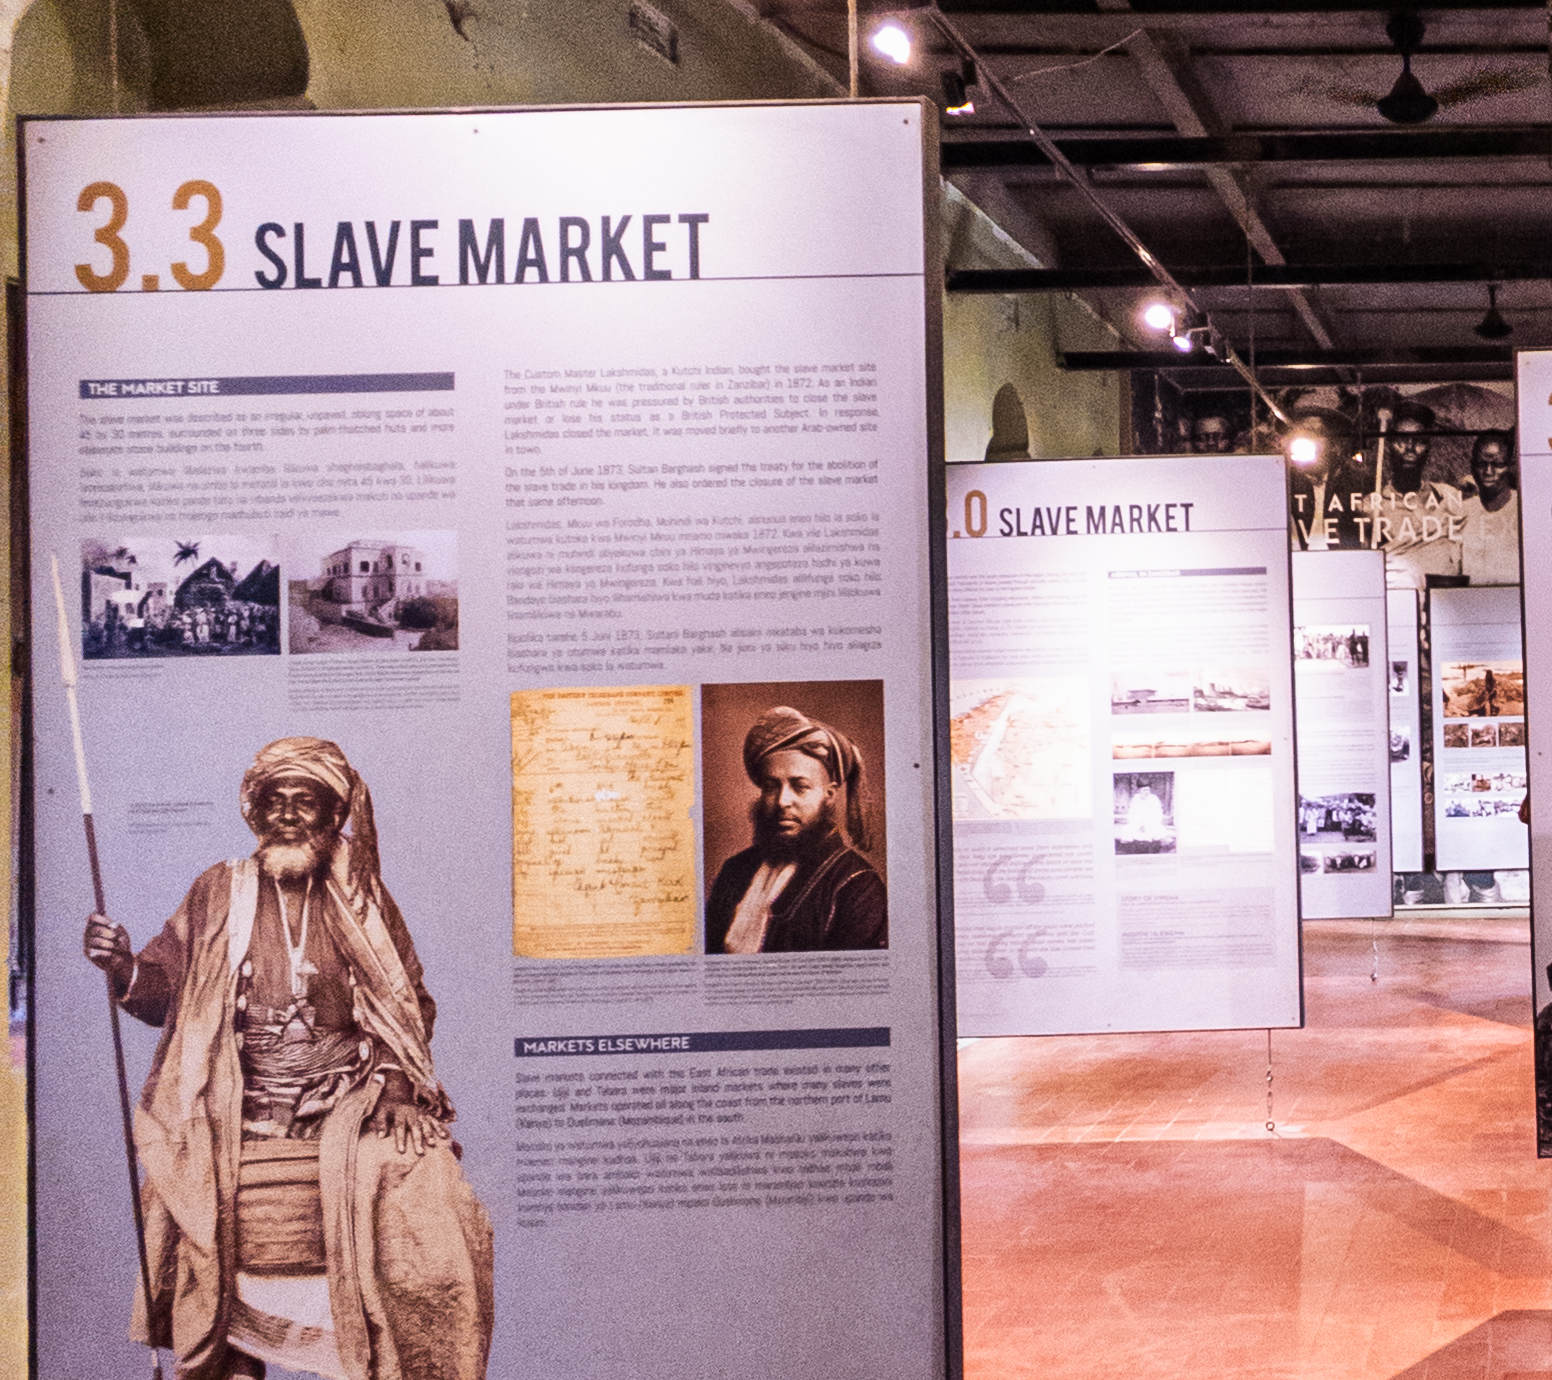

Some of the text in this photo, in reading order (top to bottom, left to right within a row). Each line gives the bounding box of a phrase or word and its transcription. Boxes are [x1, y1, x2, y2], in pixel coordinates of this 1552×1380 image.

[74, 180, 710, 292] 3.3 SLAVE MARKET
[504, 369, 520, 379] The
[525, 368, 560, 379] Custom
[565, 367, 596, 378] Master
[662, 368, 668, 376] a
[739, 364, 770, 377] bought
[775, 364, 789, 374] the
[794, 363, 817, 373] slave
[822, 362, 854, 373] market
[859, 362, 876, 372] site
[88, 380, 220, 396] THE MARKET SITE
[504, 383, 526, 393] from
[531, 383, 545, 393] the
[616, 381, 634, 394] (the
[639, 380, 685, 391] traditional
[690, 380, 710, 390] ruler
[716, 380, 723, 389] in
[728, 379, 770, 392] Zanzibar)
[775, 379, 782, 388] in
[819, 378, 829, 388] As
[850, 377, 877, 387] Indian
[504, 391, 877, 409] under British rule he was pressured by British authorities to close the slave
[504, 414, 537, 424] market
[562, 413, 581, 423] lose
[589, 412, 602, 422] his
[611, 412, 641, 422] status
[650, 413, 660, 421] as
[669, 413, 674, 421] a
[682, 410, 712, 421] British
[720, 409, 766, 420] Protected
[819, 408, 828, 418] In
[505, 428, 559, 439] Lakshmidas
[563, 428, 592, 438] closed
[596, 427, 610, 437] the
[653, 426, 659, 436] it
[663, 428, 682, 436] was
[686, 425, 715, 435] moved
[719, 424, 747, 437] briefly
[751, 424, 760, 434] to
[764, 423, 797, 434] another
[860, 421, 877, 431] site
[505, 444, 512, 454] in
[505, 466, 517, 476] On
[521, 465, 536, 475] the
[559, 465, 568, 475] of
[572, 464, 593, 474] June
[628, 463, 658, 473] Sultan
[709, 462, 738, 474] signed
[742, 461, 756, 471] the
[760, 461, 788, 473] treaty
[792, 460, 803, 470] for
[808, 460, 823, 470] the
[828, 459, 865, 469] abolition
[869, 459, 878, 469] of
[505, 482, 520, 492] the
[524, 481, 548, 491] slave
[552, 481, 576, 491] trade
[580, 480, 588, 490] in
[591, 480, 604, 490] his
[653, 479, 666, 489] He
[670, 478, 688, 488] also
[692, 477, 727, 488] ordered
[731, 477, 745, 487] the
[749, 476, 782, 487] closure
[786, 476, 795, 486] of
[799, 475, 813, 485] the
[818, 475, 841, 485] slave
[845, 474, 878, 484] market
[506, 496, 524, 506] that
[528, 498, 553, 506] same
[1328, 491, 1463, 513] AFRICAN
[949, 489, 1194, 538] .0 SLAVE MARKET
[1353, 515, 1464, 544] TRADE
[523, 1036, 690, 1054] MARKETS ELSEWHERE
[570, 1100, 608, 1111] Markets
[612, 1099, 652, 1112] operated
[656, 1099, 666, 1109] all
[670, 1098, 694, 1111] along
[698, 1098, 711, 1108] the
[716, 1097, 741, 1107] coast
[745, 1096, 767, 1106] from
[770, 1096, 784, 1106] the
[788, 1094, 827, 1105] northern
[831, 1094, 850, 1107] part
[854, 1093, 862, 1103] of
